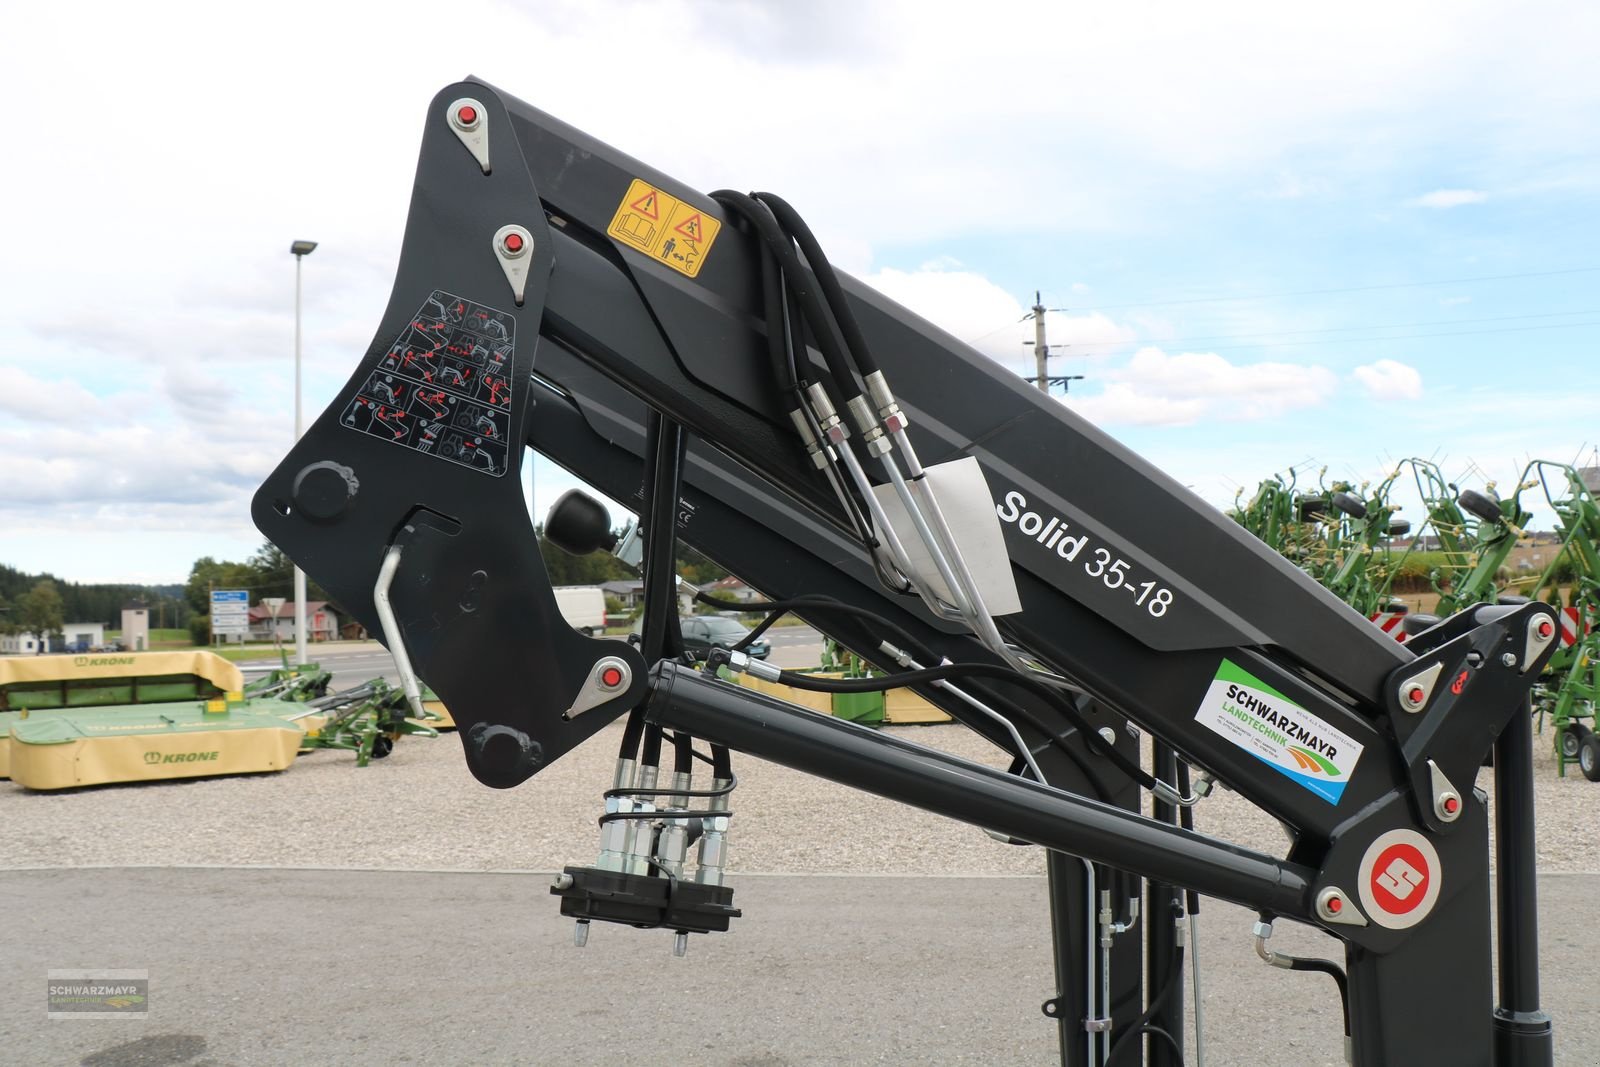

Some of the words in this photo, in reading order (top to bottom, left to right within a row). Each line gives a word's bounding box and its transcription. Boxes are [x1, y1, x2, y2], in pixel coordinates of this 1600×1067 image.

[996, 490, 1089, 562] Solid
[1084, 547, 1173, 617] 35-18
[89, 657, 136, 666] KRONE
[1222, 701, 1289, 748] LANDTECHNIK
[1226, 684, 1338, 761] SCHWARZMAYR
[162, 751, 220, 764] KRONE
